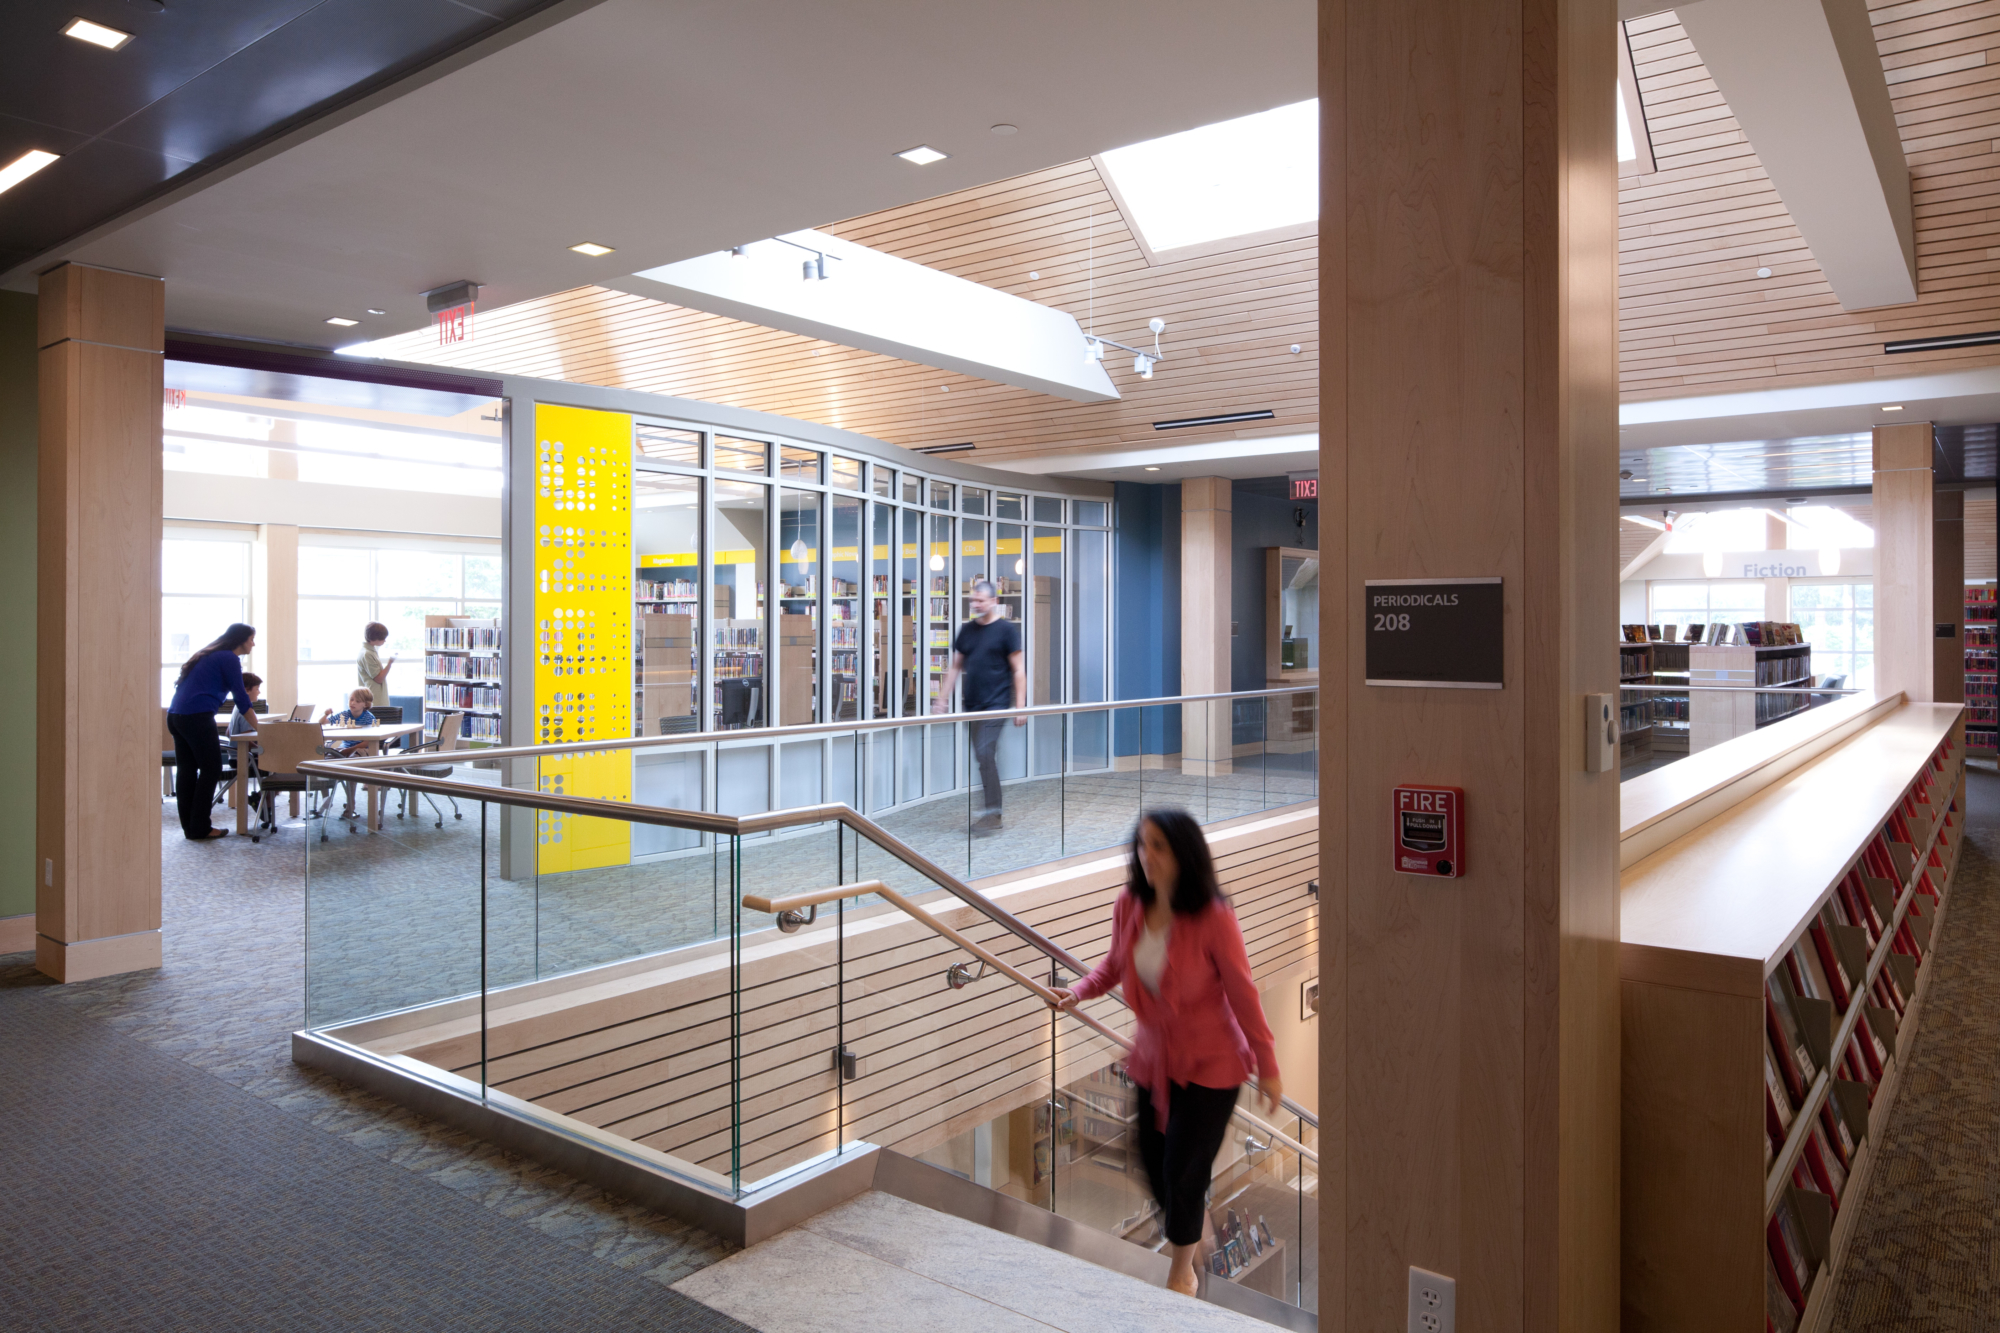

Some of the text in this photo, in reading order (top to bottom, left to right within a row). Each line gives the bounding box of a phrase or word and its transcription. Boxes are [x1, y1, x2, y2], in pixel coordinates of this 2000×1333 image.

[1743, 563, 1807, 578] Fiction
[1373, 593, 1459, 607] PERIODICALS
[1373, 613, 1411, 631] 208
[1400, 792, 1447, 812] FIRE
